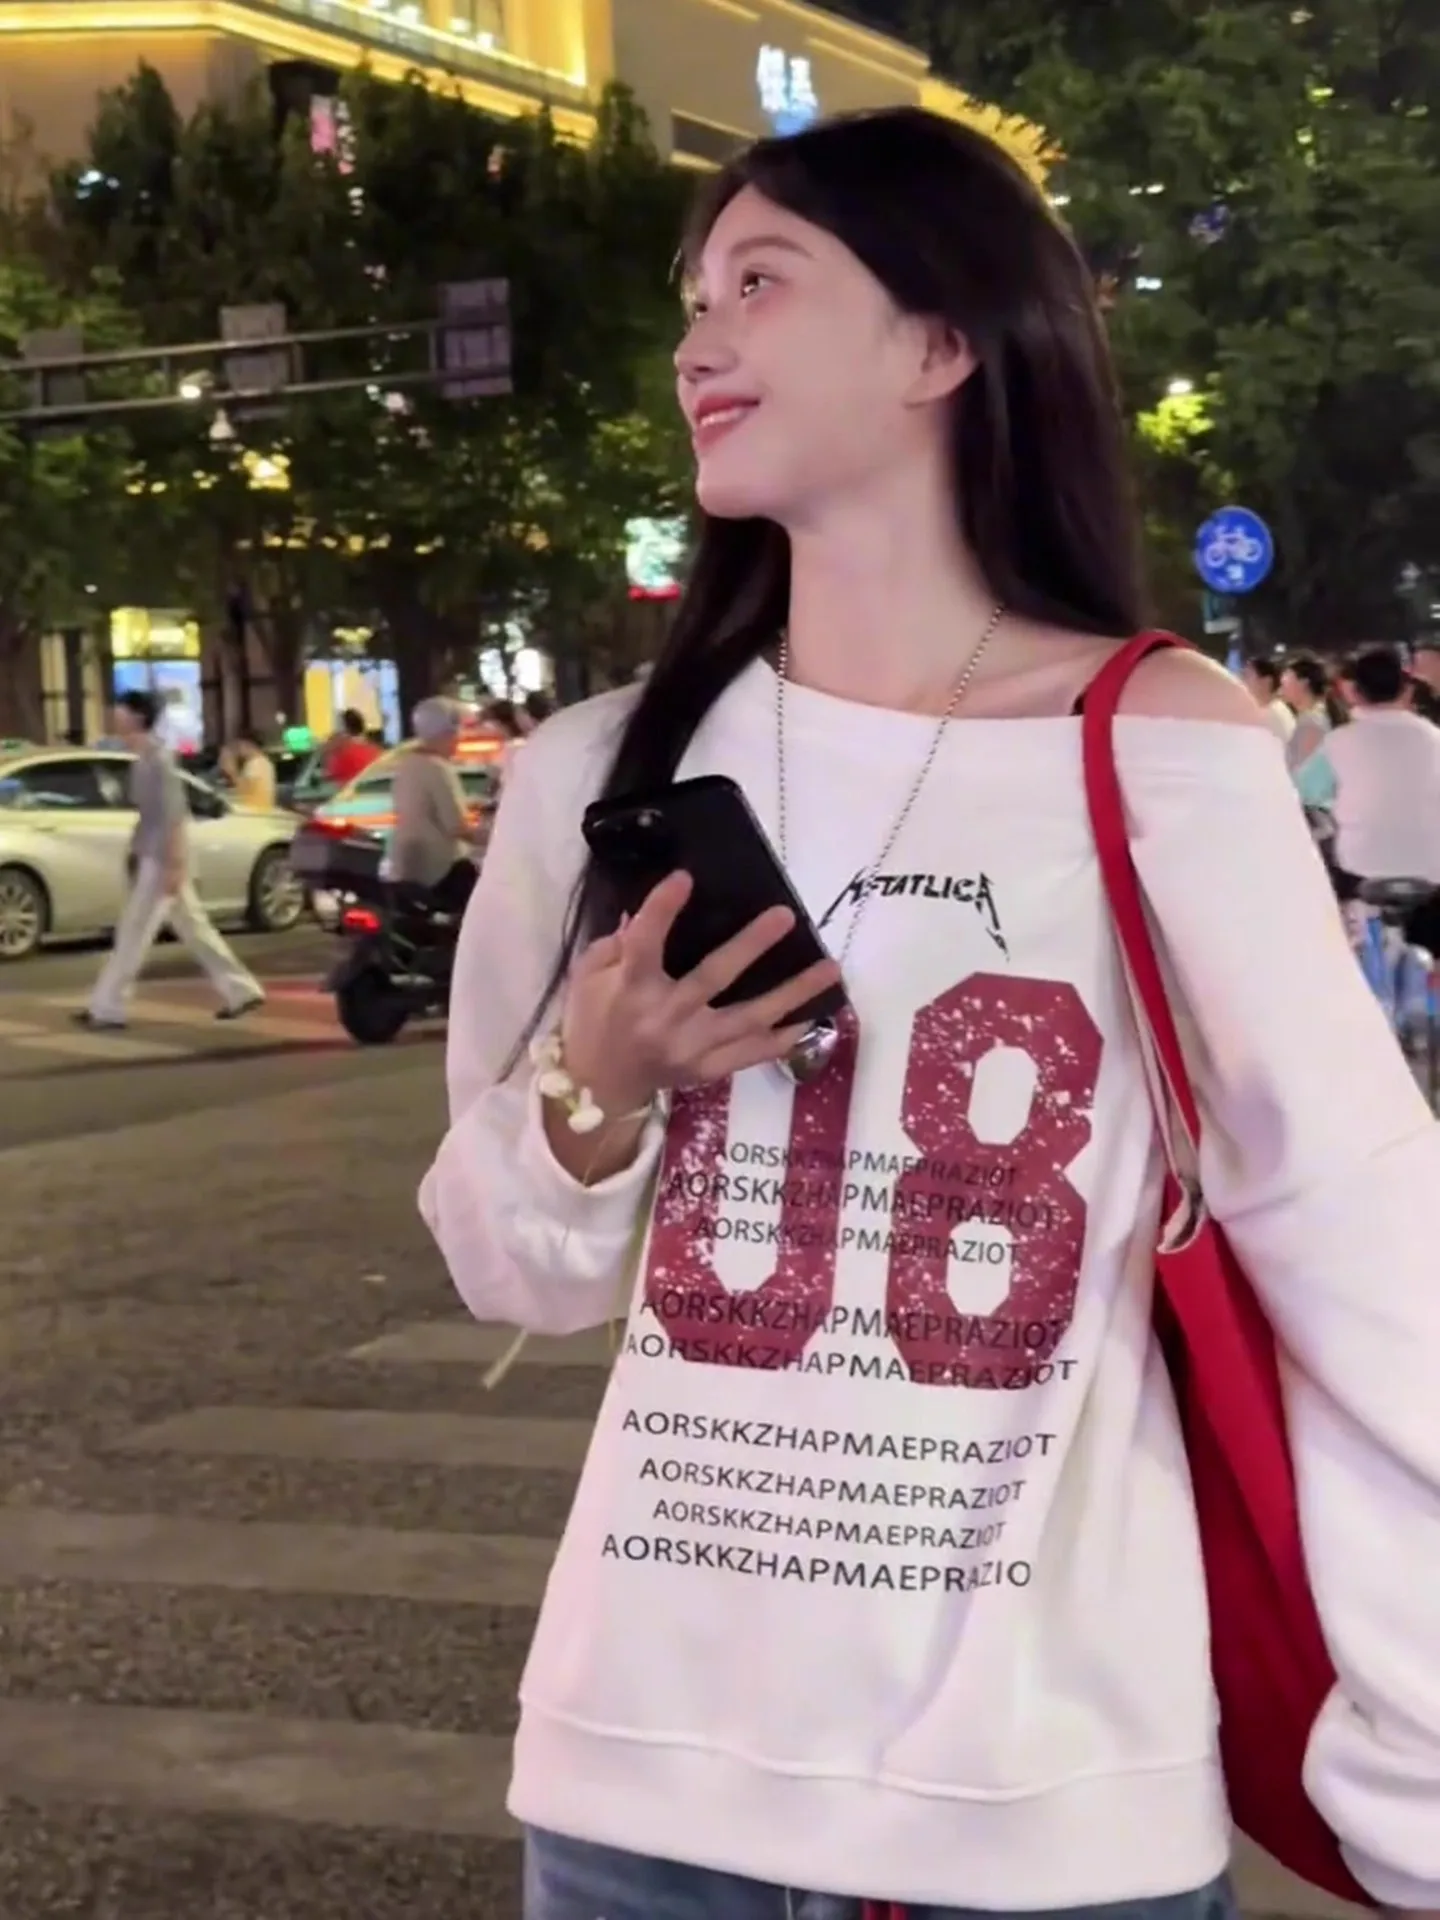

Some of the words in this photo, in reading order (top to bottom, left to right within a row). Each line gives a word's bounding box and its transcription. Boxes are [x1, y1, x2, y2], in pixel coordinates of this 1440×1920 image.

[714, 1142, 1017, 1186] AORSKPMAEPRAZIOT
[622, 1409, 1056, 1463] AORSKKZHAPMAEPRAZIOT
[639, 1458, 1026, 1509] AORSKKZHAPMAEPRAZIOT
[652, 1499, 1005, 1549] AORSKKZHAPMAEPRAZIOT
[601, 1534, 1031, 1592] AORSKKZHAPMAEPRAZIO
